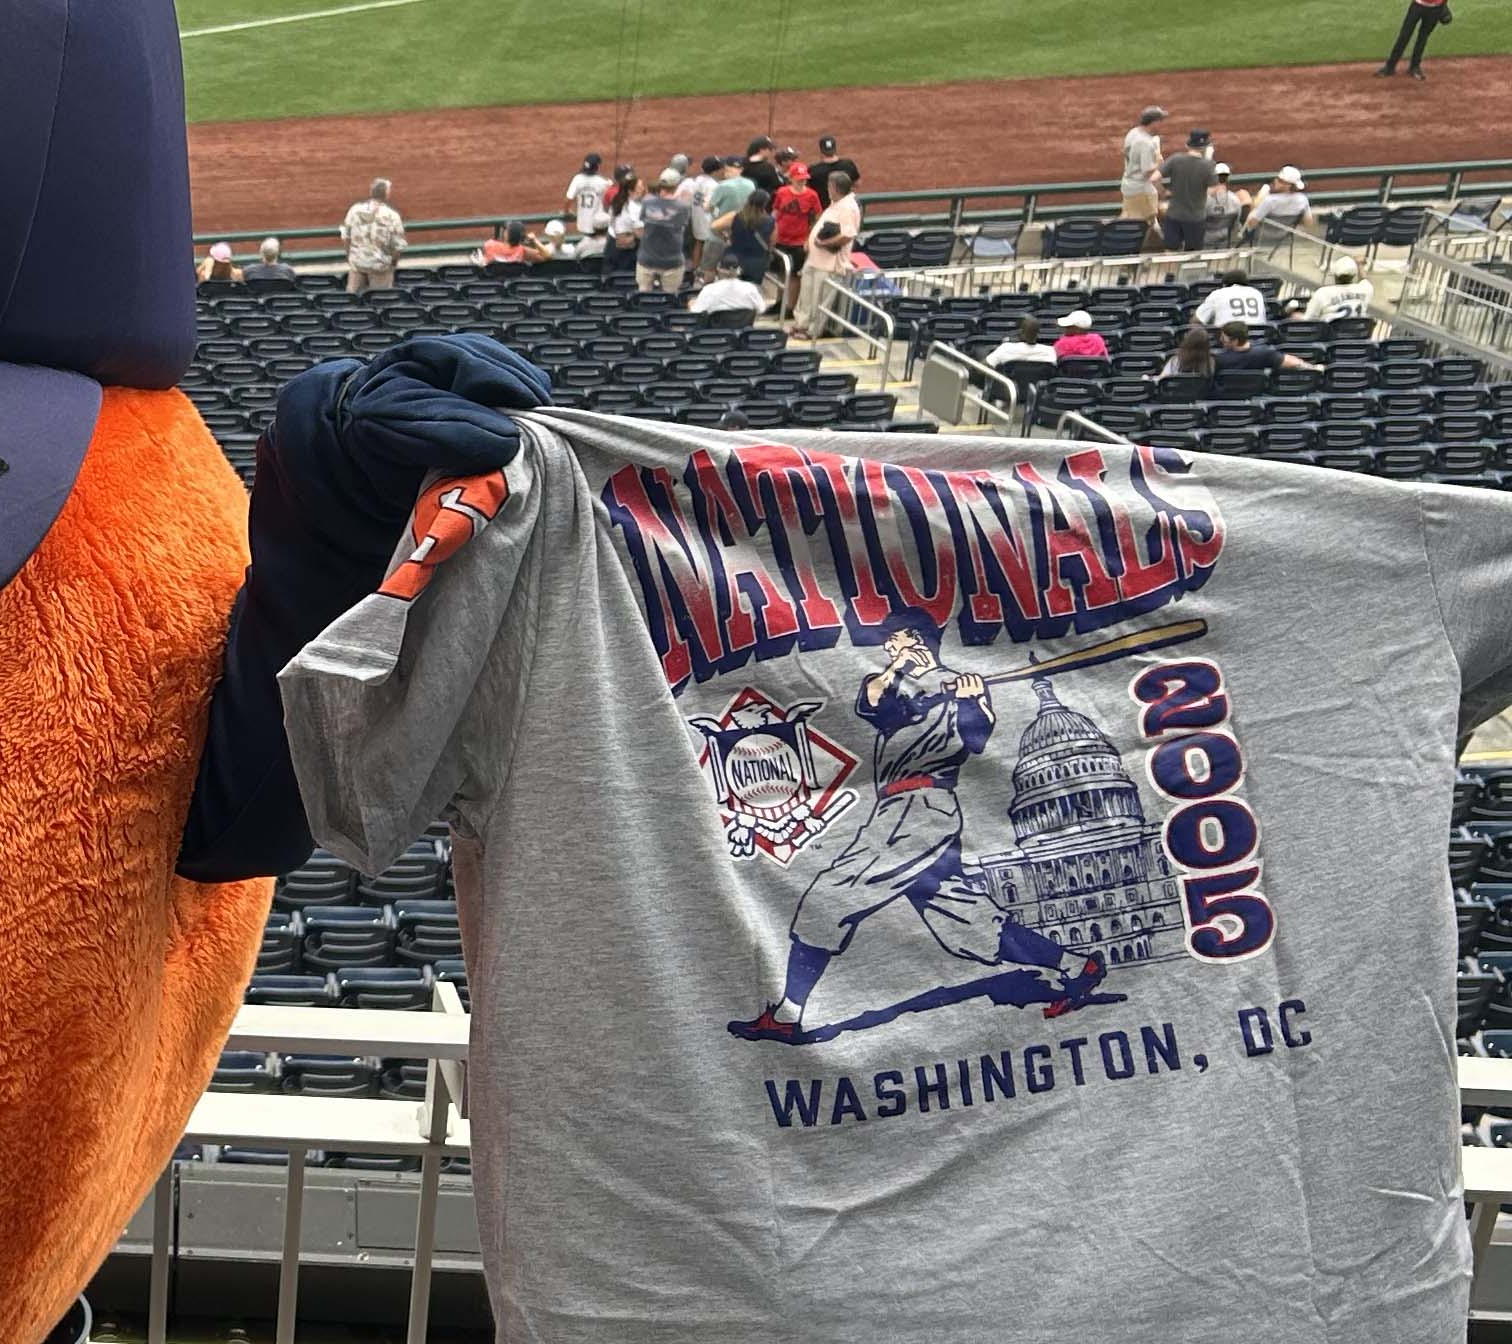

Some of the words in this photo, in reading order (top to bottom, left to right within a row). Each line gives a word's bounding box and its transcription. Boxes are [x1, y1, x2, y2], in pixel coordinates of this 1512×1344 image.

[1229, 297, 1259, 318] 99
[601, 445, 1227, 699] NATIONALS
[731, 752, 798, 788] NATIONAL
[1128, 657, 1277, 963] 2005
[765, 1023, 1210, 1127] WASHINGTON,
[1238, 999, 1314, 1058] DC
